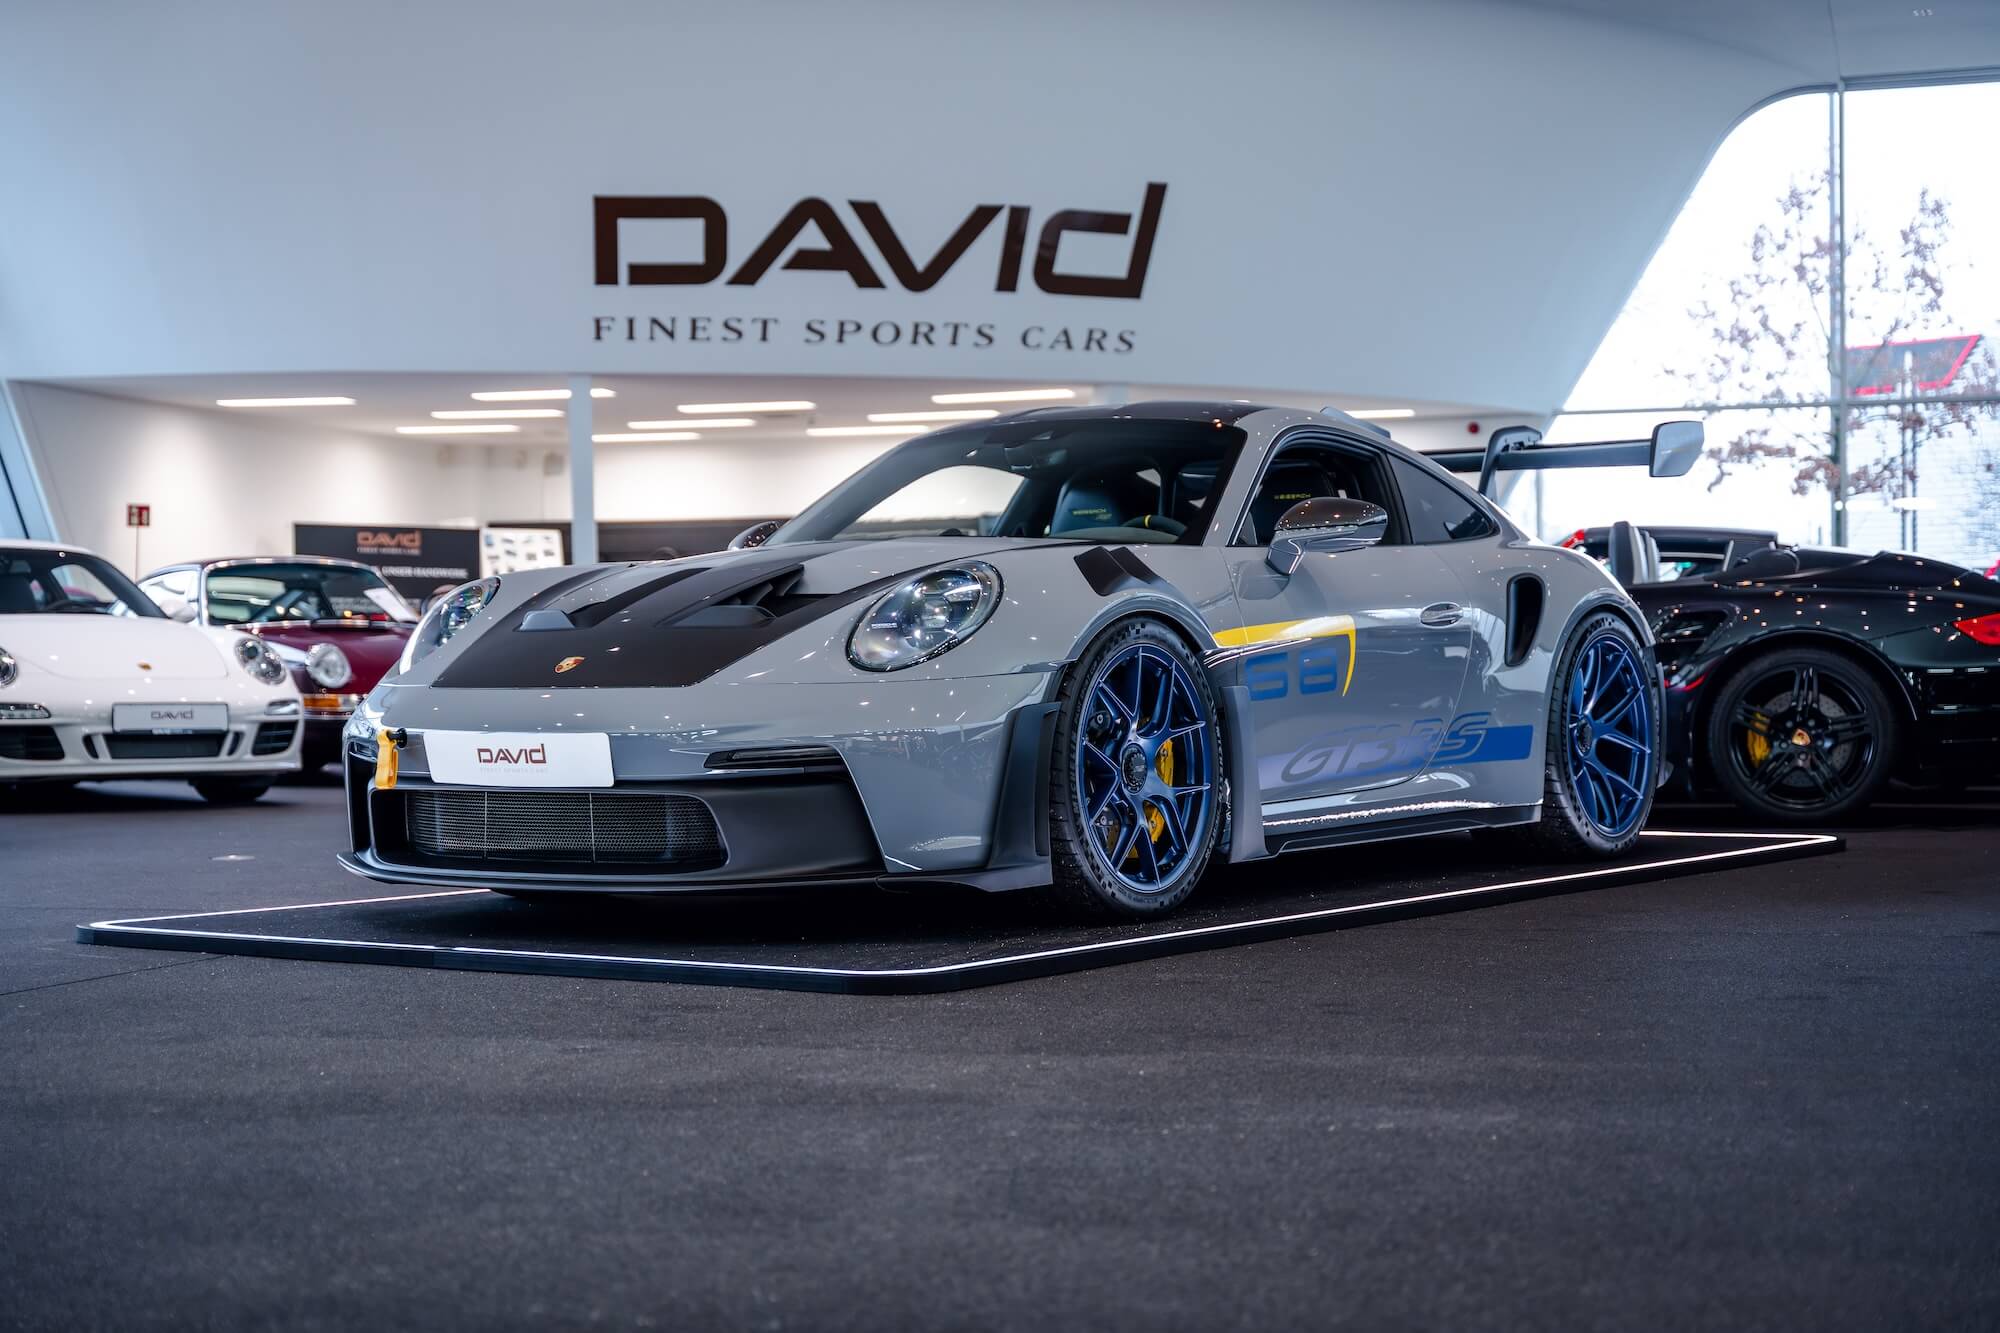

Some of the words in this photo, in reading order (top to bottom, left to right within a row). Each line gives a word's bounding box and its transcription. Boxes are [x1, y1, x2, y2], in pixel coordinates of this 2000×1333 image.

[593, 316, 780, 343] FINEST
[803, 319, 996, 348] SPORTS
[1020, 326, 1138, 353] CARS
